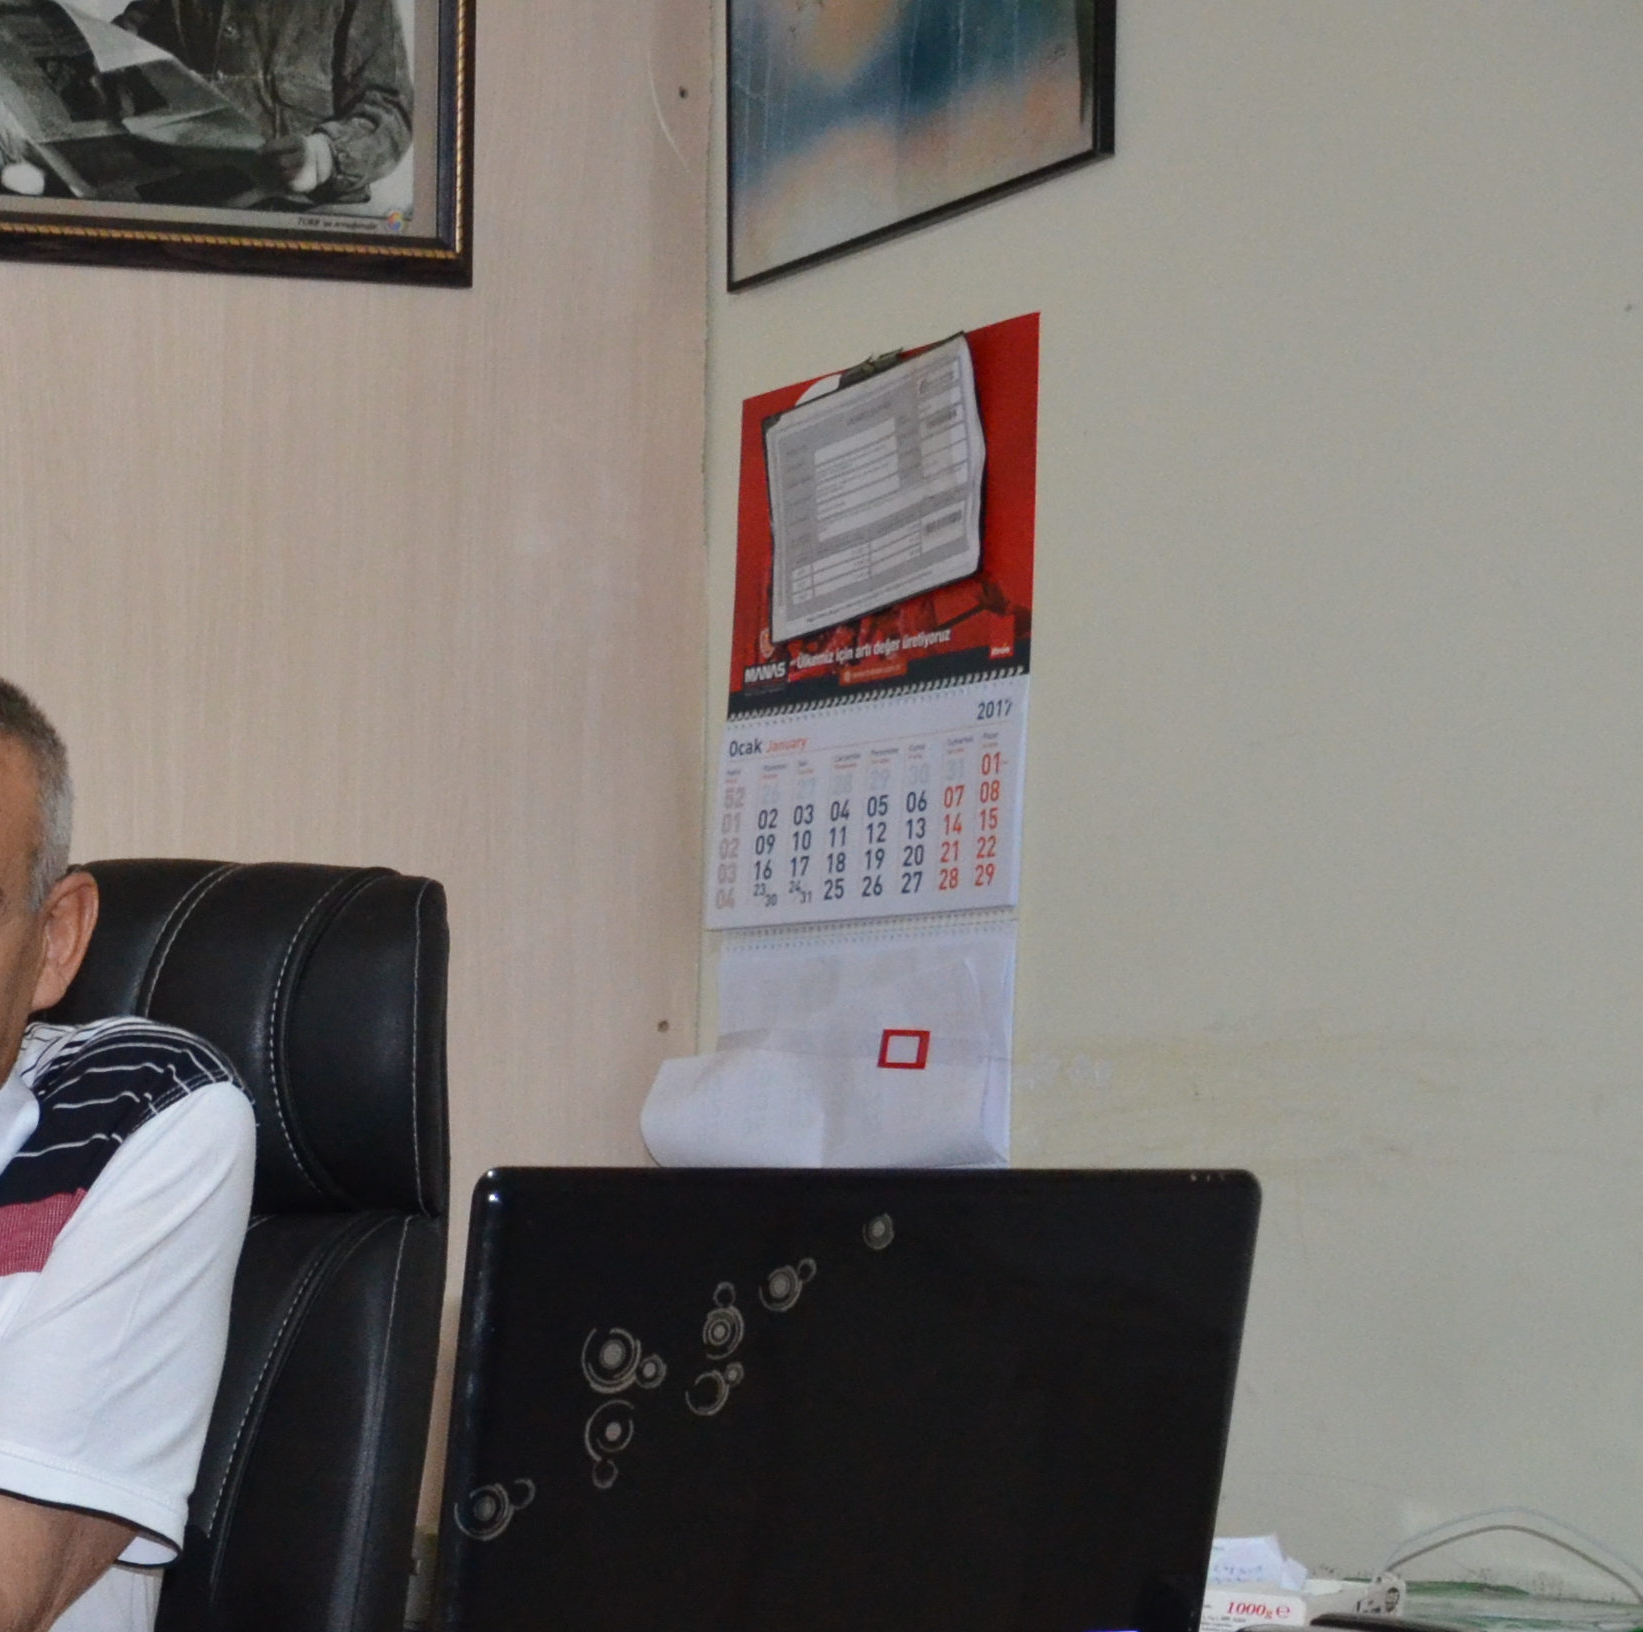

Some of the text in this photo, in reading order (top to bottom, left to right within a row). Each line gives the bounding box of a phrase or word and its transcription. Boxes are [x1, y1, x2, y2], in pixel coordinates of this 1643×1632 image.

[797, 628, 951, 669] Ülkemiz için artı değer üretiyoruz
[744, 661, 786, 684] MANAS
[977, 700, 1013, 720] 2017
[728, 736, 808, 757] Ocak January
[981, 752, 1001, 775] 01
[758, 808, 778, 830] 02
[793, 804, 814, 826] 03
[830, 799, 850, 822] 04
[867, 794, 888, 817] 05
[906, 790, 928, 813] 06
[944, 784, 965, 808] 07
[980, 780, 1000, 803] 08
[755, 833, 776, 855] 09
[792, 830, 811, 851] 10
[829, 826, 847, 848] 11
[866, 821, 887, 844] 12
[906, 817, 926, 840] 13
[943, 812, 962, 835] 14
[980, 807, 998, 831] 15
[753, 860, 772, 880] 16
[790, 855, 809, 877] 17
[826, 852, 846, 874] 18
[864, 848, 885, 870] 19
[902, 844, 924, 867] 20
[940, 840, 959, 863] 21
[976, 835, 996, 859] 22
[824, 878, 844, 900] 25
[862, 874, 883, 897] 26
[901, 871, 923, 894] 27
[939, 867, 959, 891] 28
[974, 863, 995, 887] 29
